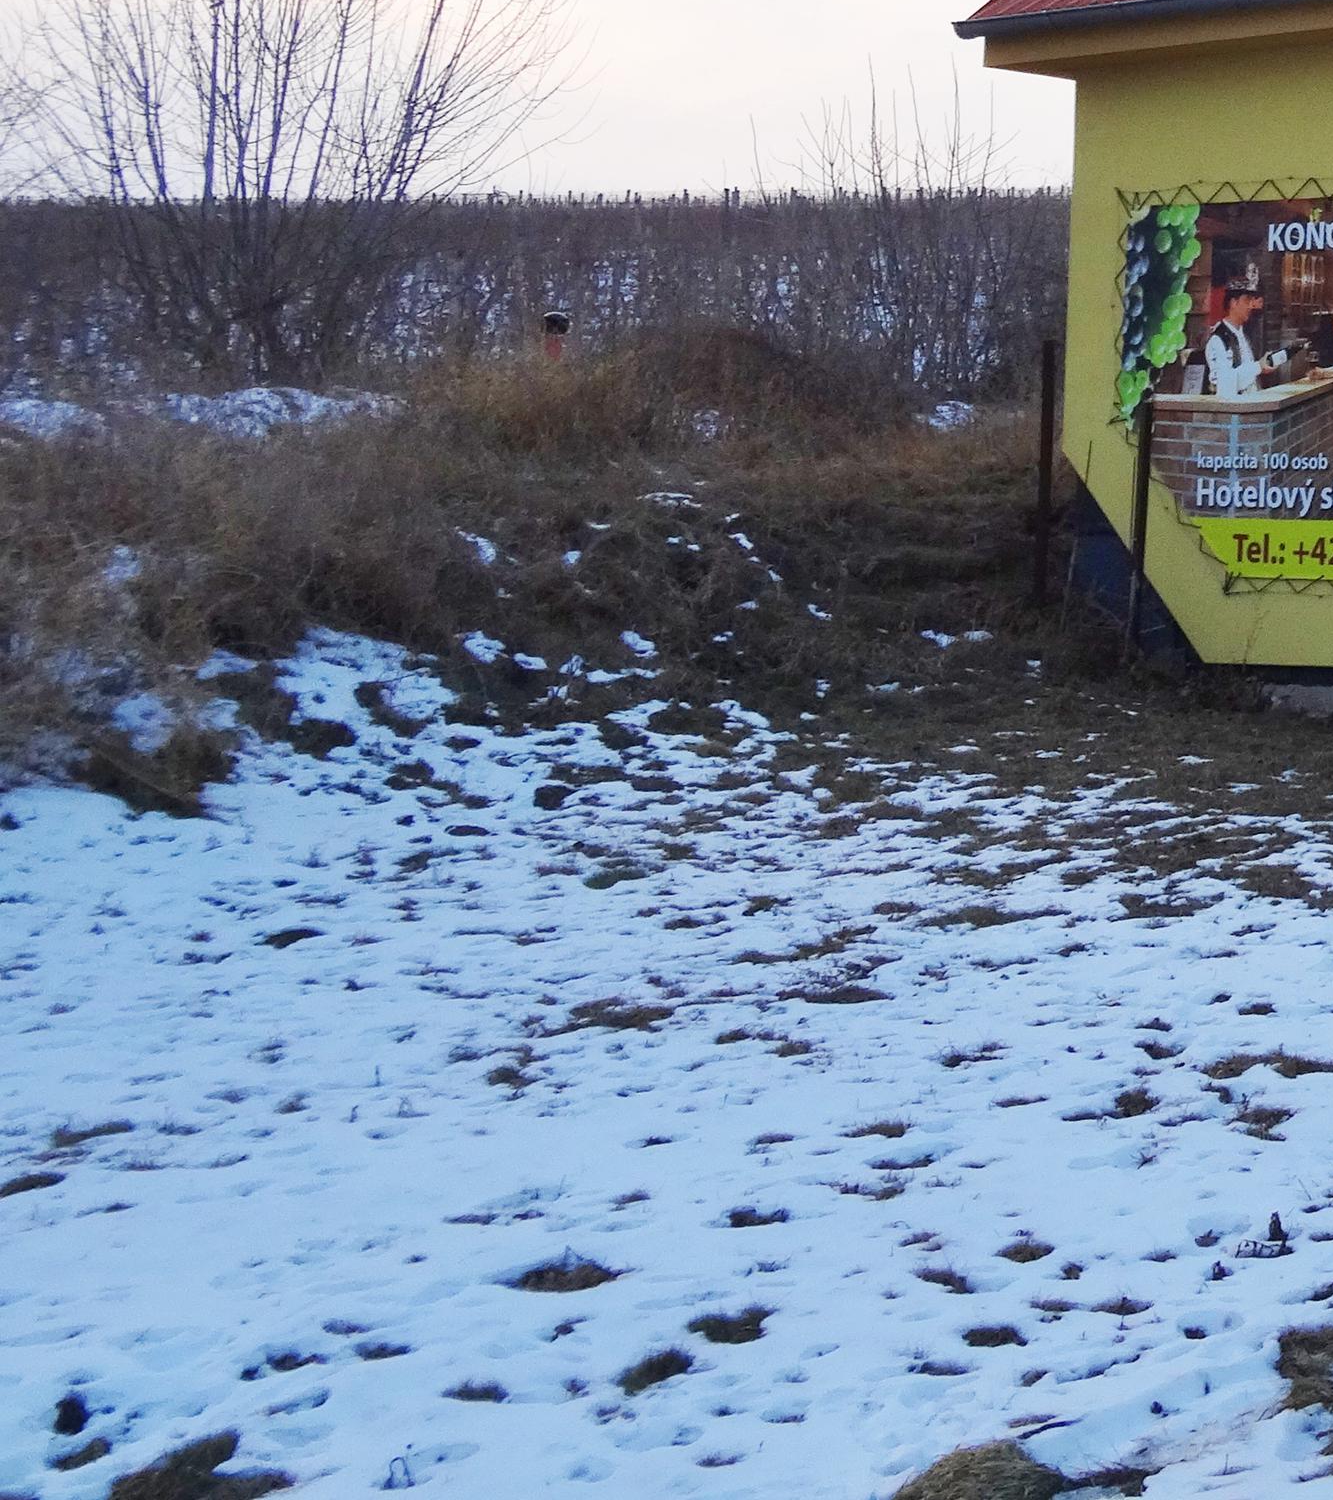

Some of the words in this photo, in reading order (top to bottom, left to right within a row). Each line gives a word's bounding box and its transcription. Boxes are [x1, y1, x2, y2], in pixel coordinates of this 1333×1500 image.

[1196, 452, 1258, 473] kapacita
[1262, 453, 1288, 470] 100
[1291, 452, 1329, 470] osob
[1196, 478, 1317, 516] Hotelový
[1233, 533, 1286, 565] Tel.:
